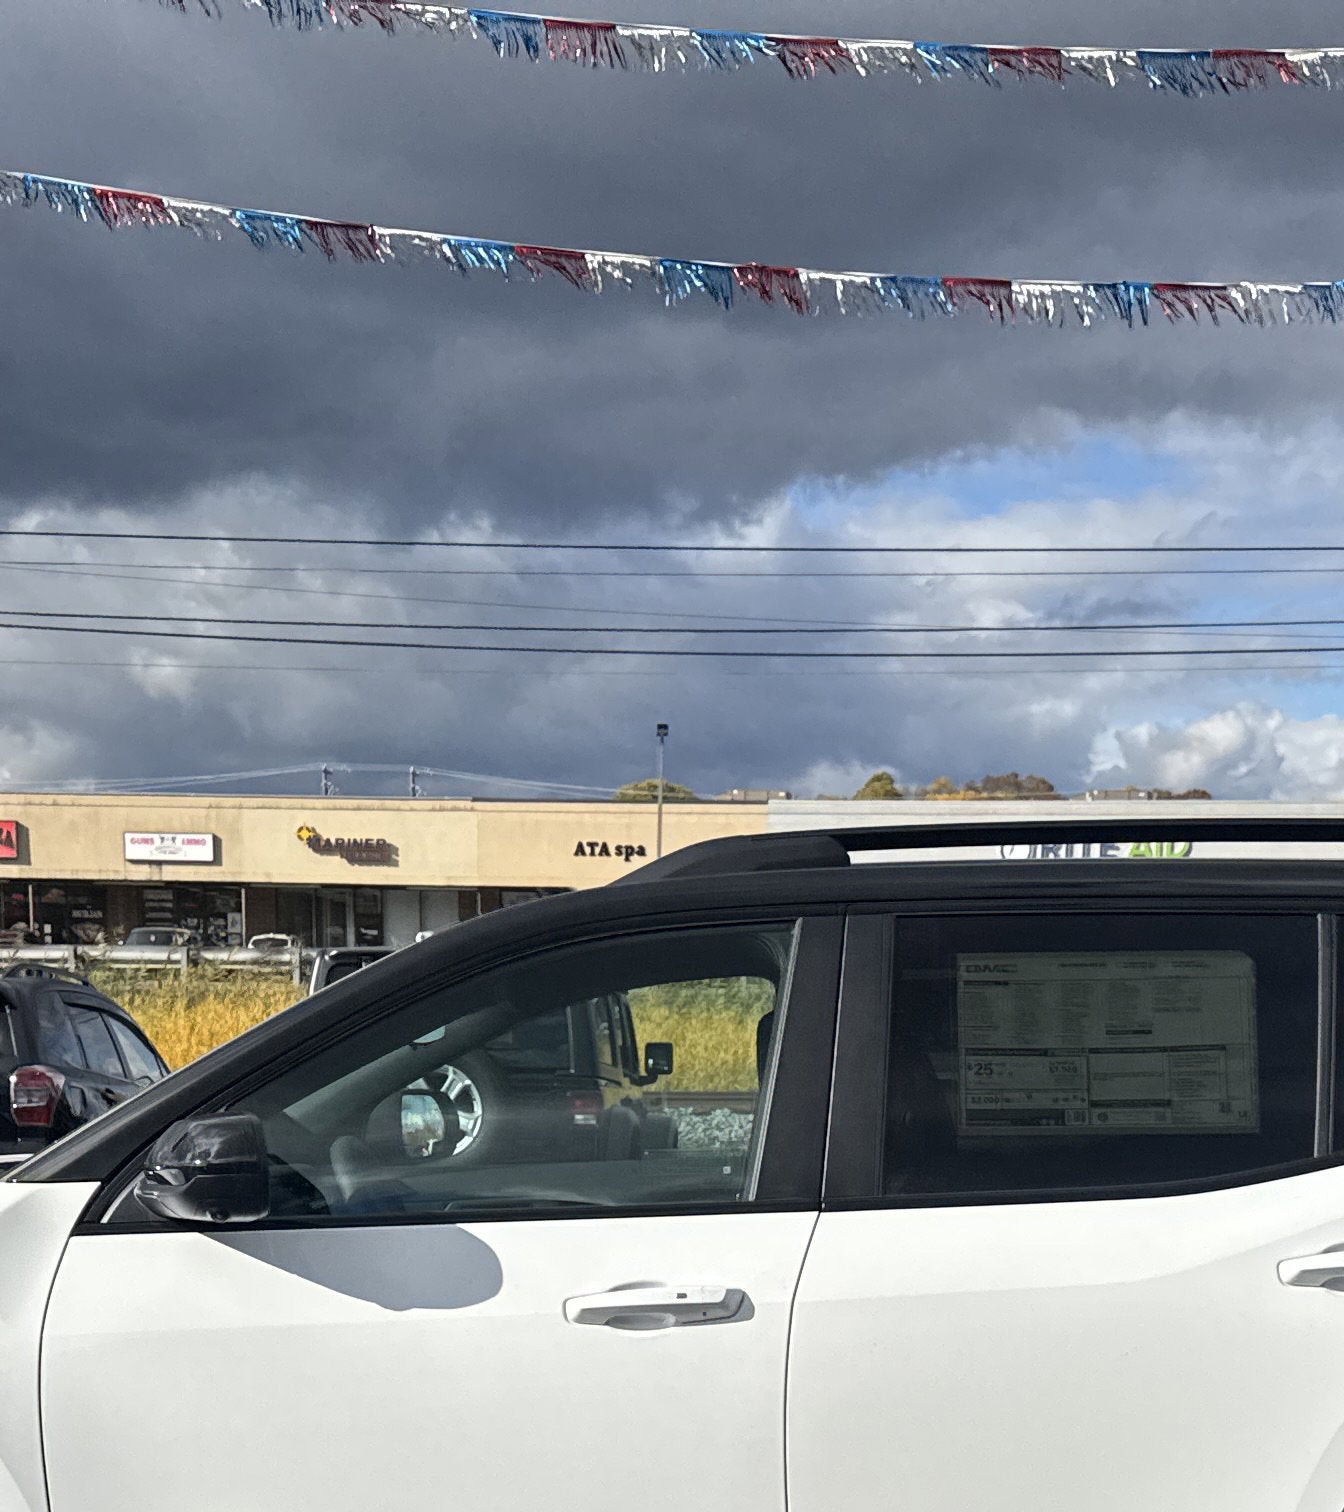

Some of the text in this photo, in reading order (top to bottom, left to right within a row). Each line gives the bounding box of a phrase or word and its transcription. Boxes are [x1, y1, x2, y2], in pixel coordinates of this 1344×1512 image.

[130, 837, 155, 846] GUNS
[307, 838, 387, 850] MARINER
[574, 841, 647, 862] ATA spa
[974, 1062, 994, 1076] 25
